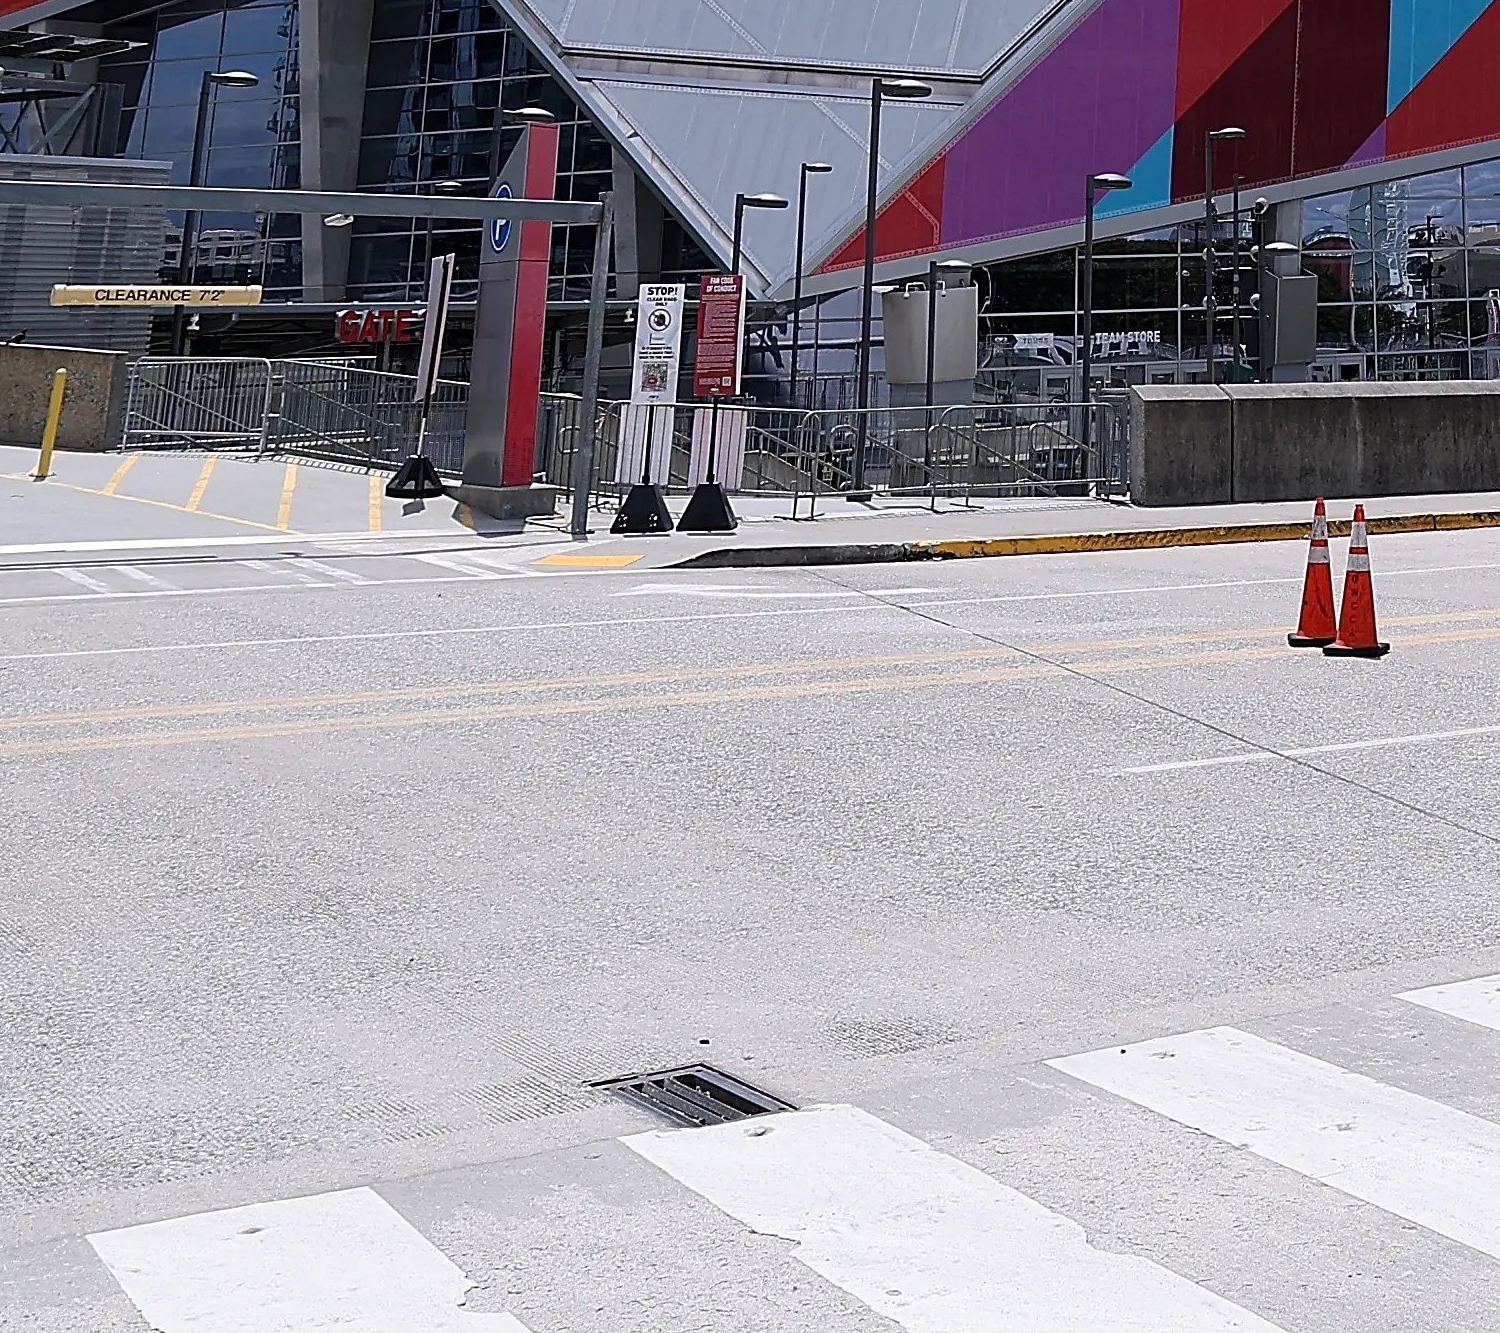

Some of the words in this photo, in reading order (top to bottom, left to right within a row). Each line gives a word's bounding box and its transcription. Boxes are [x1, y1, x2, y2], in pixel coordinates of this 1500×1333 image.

[94, 289, 192, 301] CLEARANCE
[199, 289, 226, 301] 7'2"
[647, 286, 678, 295] STOP!
[338, 309, 414, 342] GATE
[1095, 332, 1125, 343] TEAM
[1128, 331, 1161, 343] STORE
